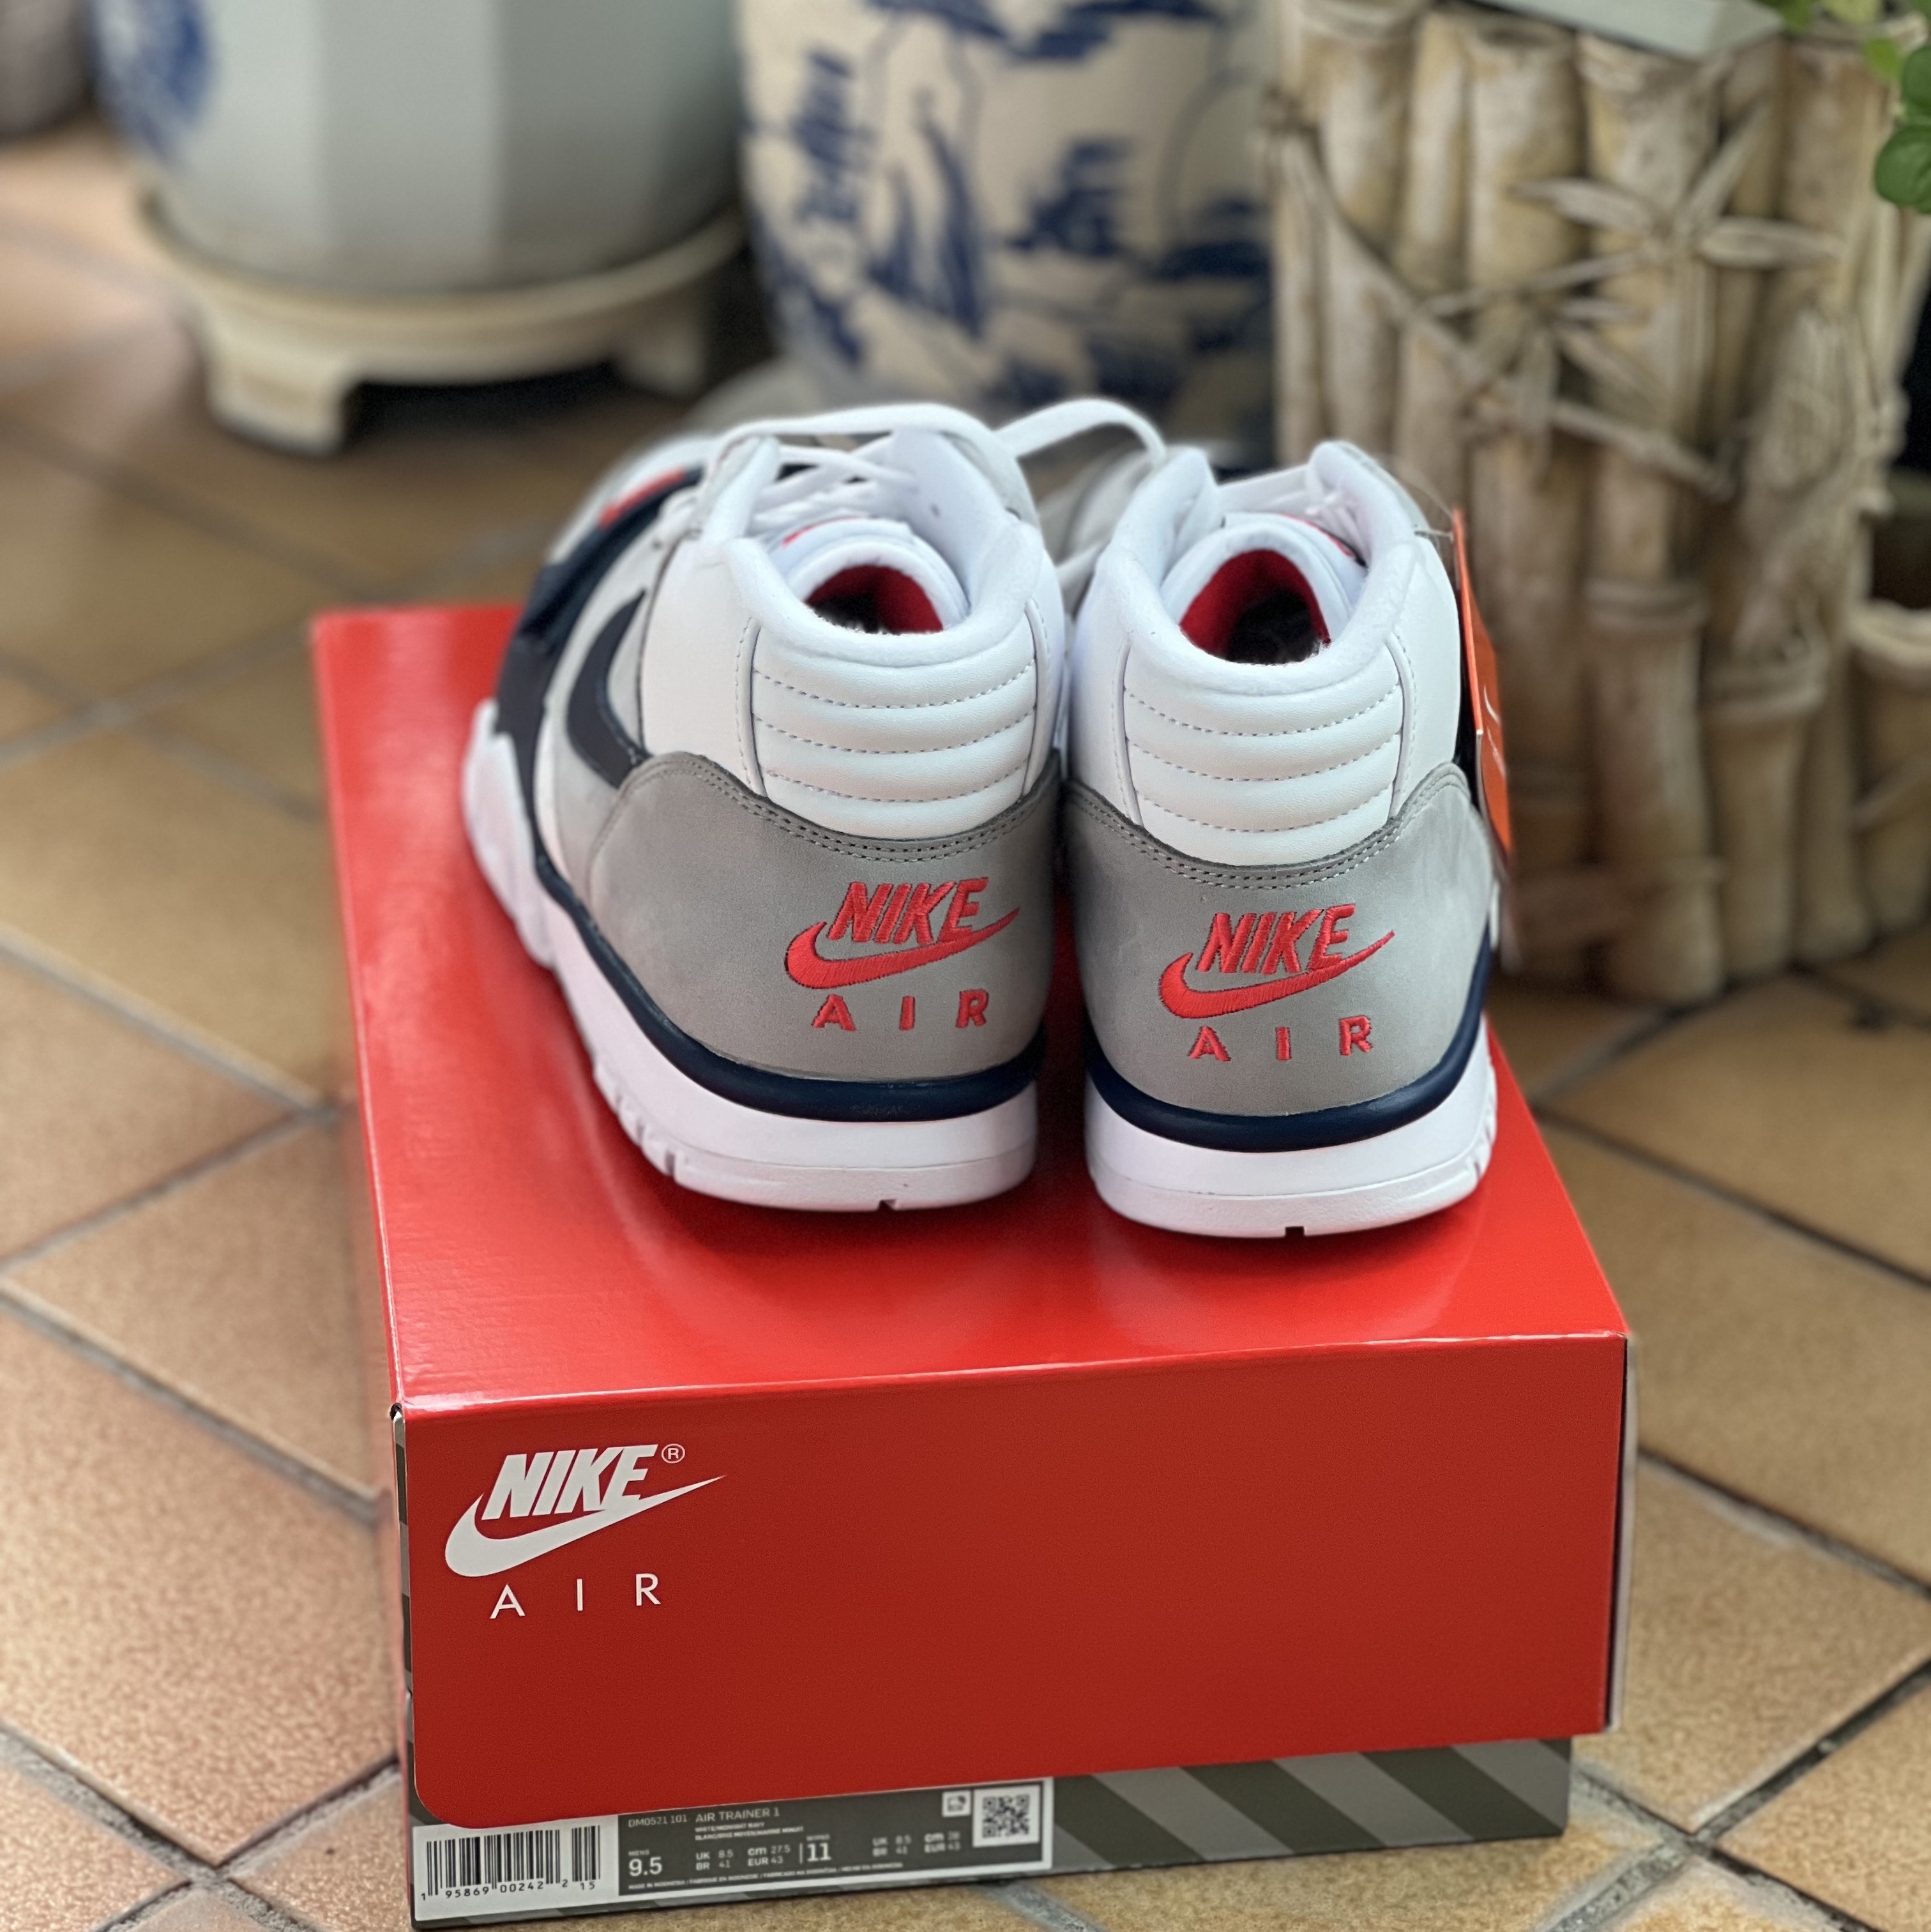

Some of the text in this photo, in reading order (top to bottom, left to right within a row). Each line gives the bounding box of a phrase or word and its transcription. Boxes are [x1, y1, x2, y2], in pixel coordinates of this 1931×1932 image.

[826, 876, 989, 944] NIKE
[1195, 903, 1356, 975] NIKE
[811, 988, 990, 1031] AIR
[1187, 1014, 1374, 1061] AIR
[481, 1443, 658, 1521] NIKE
[490, 1572, 661, 1620] AIR
[628, 1814, 688, 1827] DM0521 101
[695, 1807, 780, 1823] AIR TRAINER 1
[695, 1849, 734, 1860] UK 8.5
[747, 1847, 768, 1857] cm
[747, 1855, 784, 1866] EUR 43
[806, 1842, 832, 1862] 11
[628, 1856, 663, 1876] 9.5
[695, 1862, 710, 1871] BR
[420, 1878, 596, 1901] 1 95869 00242 2 15
